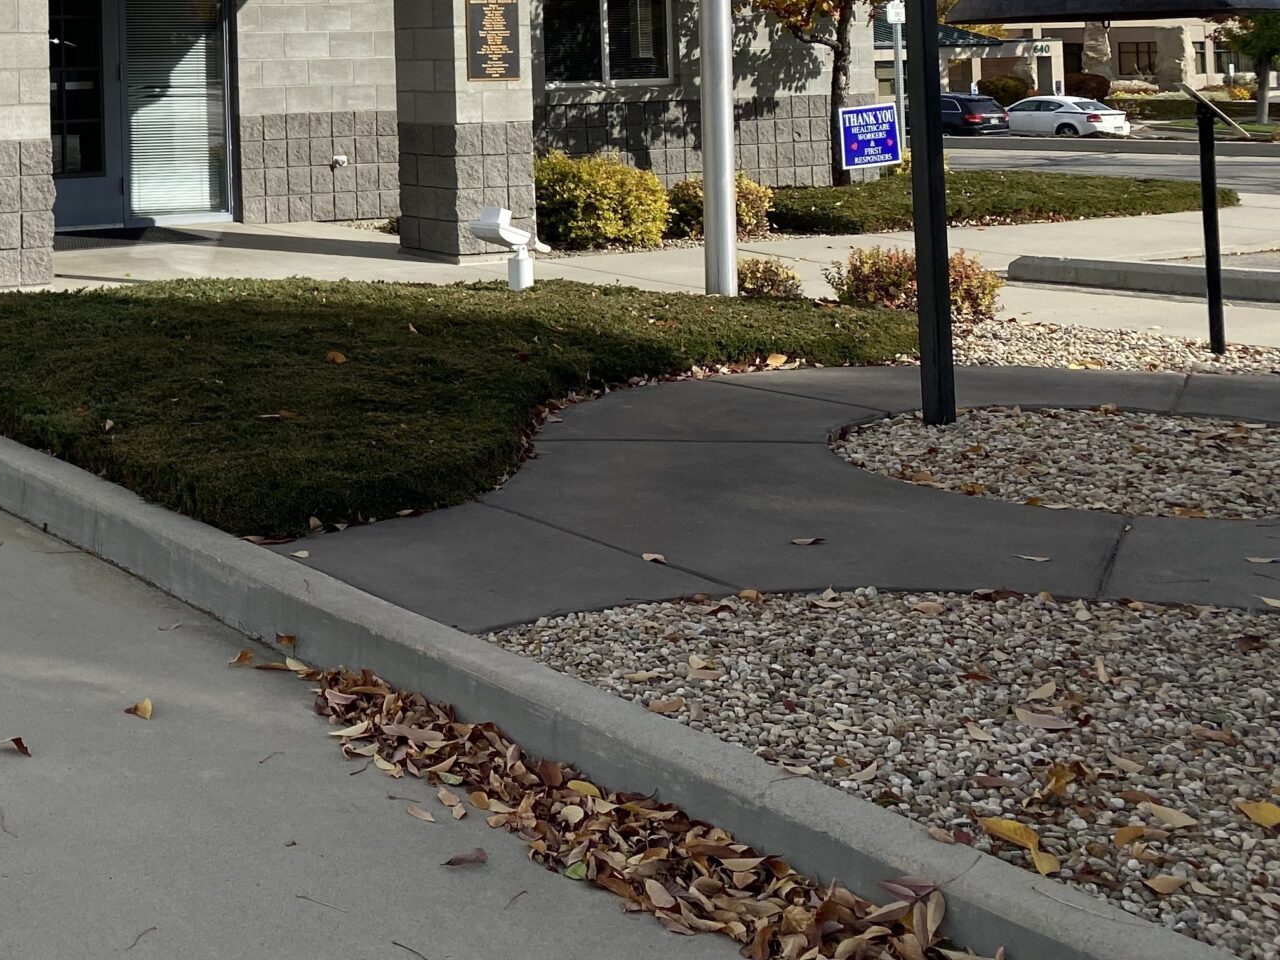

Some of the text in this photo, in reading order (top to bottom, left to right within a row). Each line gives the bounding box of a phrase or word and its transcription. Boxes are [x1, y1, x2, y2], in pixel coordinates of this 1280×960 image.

[1033, 44, 1050, 54] 640
[843, 109, 894, 127] THANK YOU
[851, 123, 890, 134] HEALTHCARE
[857, 131, 887, 141] WORKERS
[864, 147, 882, 155] FIRST
[854, 153, 892, 164] RESPONDERS
